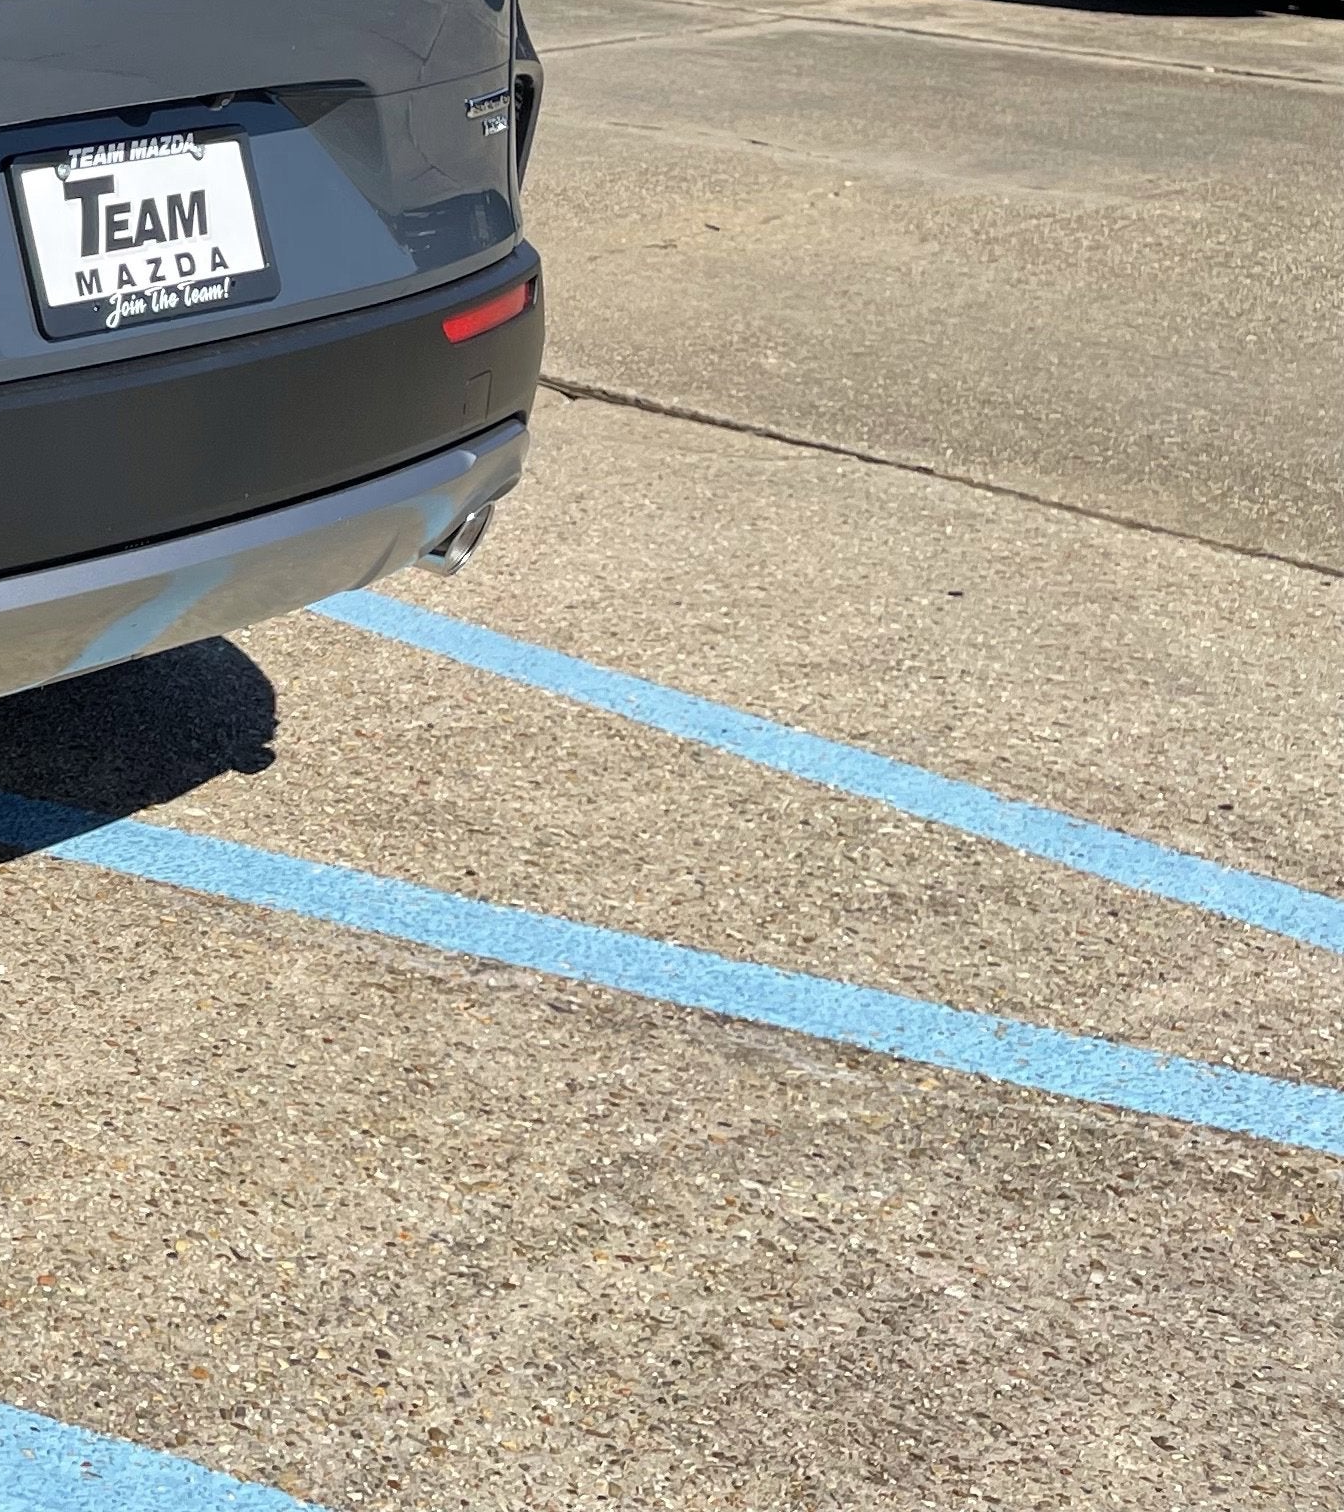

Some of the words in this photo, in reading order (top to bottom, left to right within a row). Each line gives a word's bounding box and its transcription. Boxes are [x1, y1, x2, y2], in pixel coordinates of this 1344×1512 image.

[69, 142, 126, 169] TEAM
[129, 132, 197, 161] MAZDA
[63, 174, 209, 258] TEAM
[75, 246, 229, 296] MAZDA
[105, 293, 147, 328] Join
[145, 286, 179, 313] The
[177, 276, 231, 307] Team!
